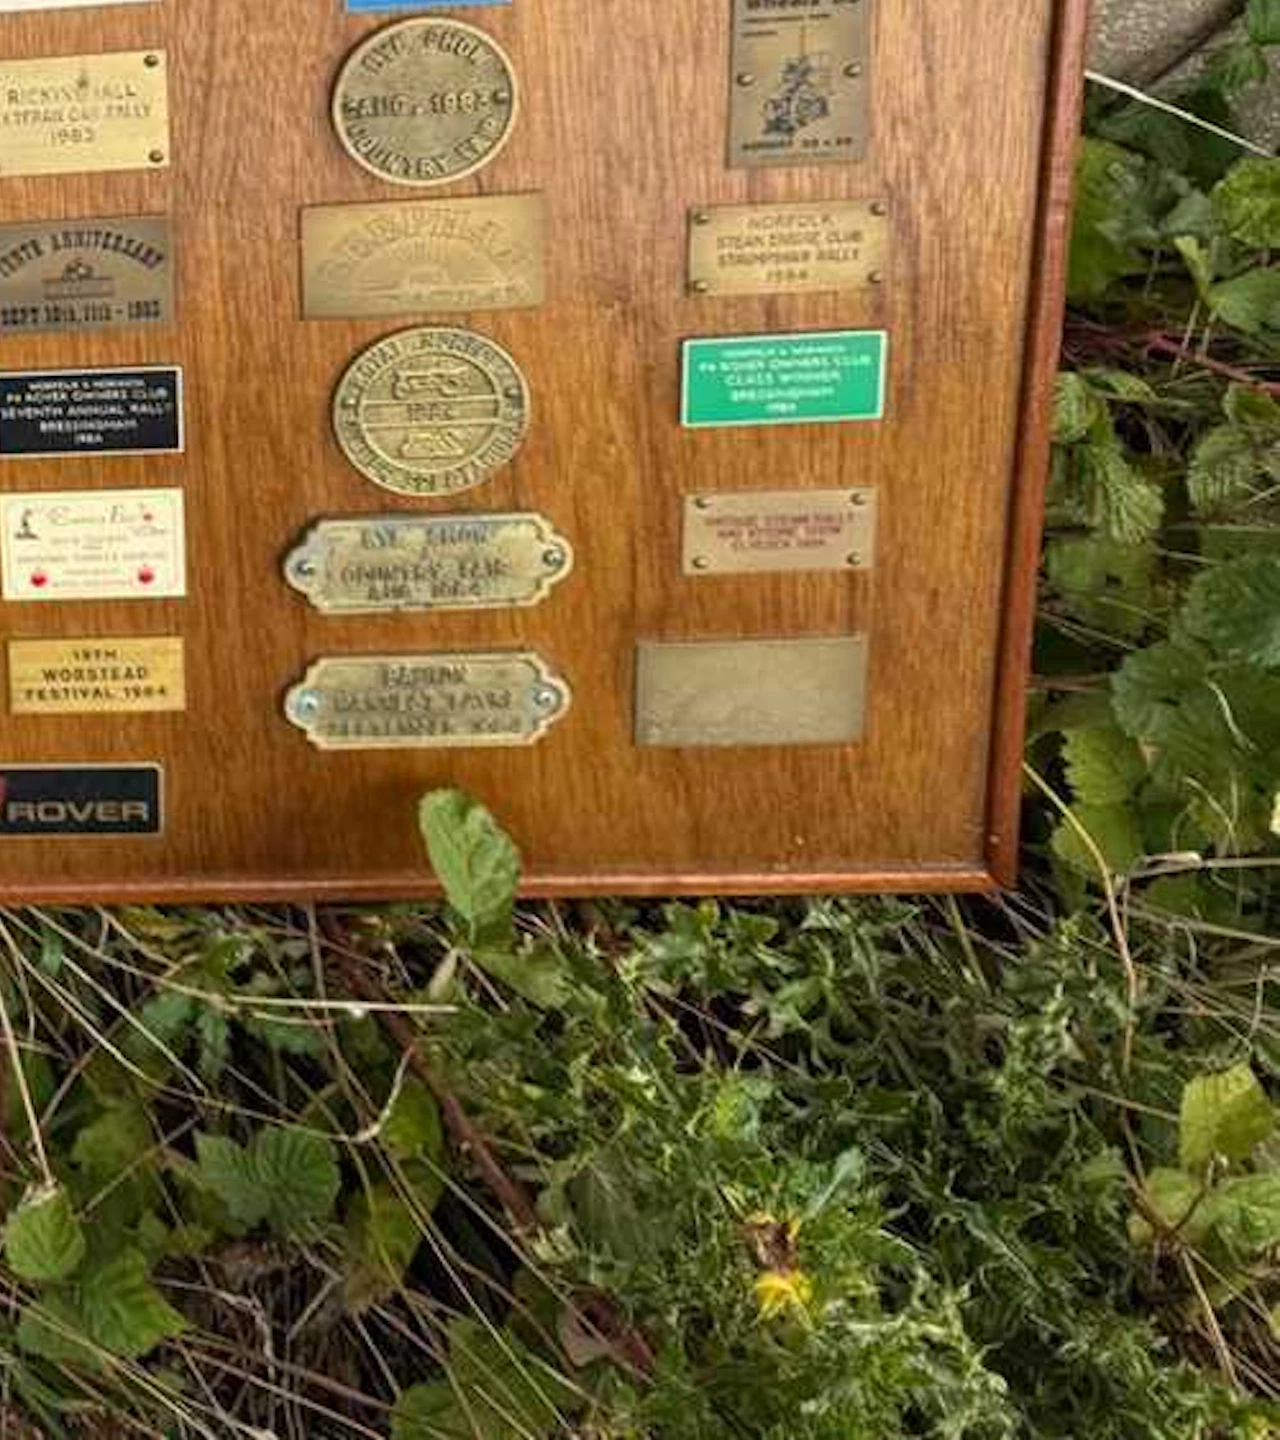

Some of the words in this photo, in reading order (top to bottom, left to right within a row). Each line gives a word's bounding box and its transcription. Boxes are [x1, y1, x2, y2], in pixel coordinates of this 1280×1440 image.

[68, 404, 125, 417] ANNUAL
[42, 667, 149, 683] WORSTEAD
[25, 685, 112, 701] FESTIVAL
[6, 801, 149, 823] ROVER
